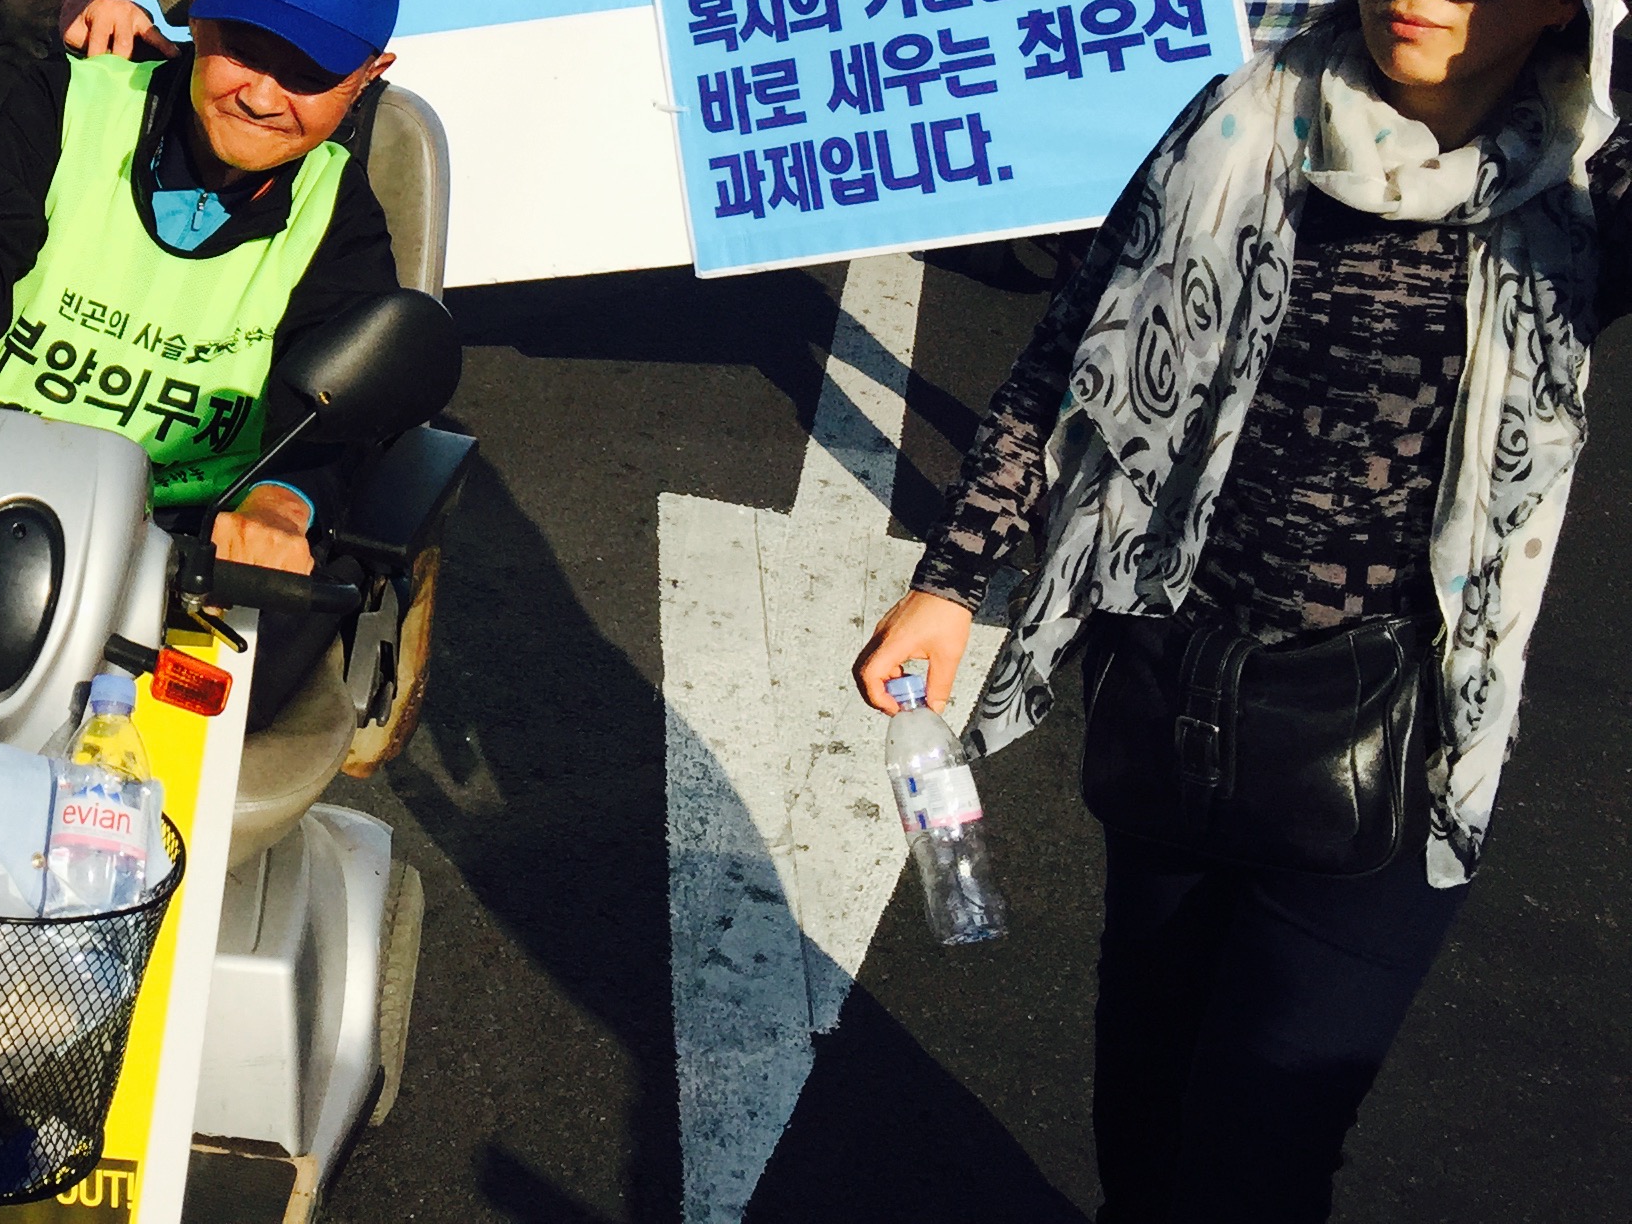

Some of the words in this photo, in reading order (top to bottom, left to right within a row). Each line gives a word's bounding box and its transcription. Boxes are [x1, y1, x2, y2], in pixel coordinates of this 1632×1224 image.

[696, 57, 807, 135] 바로
[827, 27, 999, 115] 세우는
[708, 112, 1015, 220] 과제입니다.
[57, 287, 131, 342] 빈곤의
[132, 322, 188, 363] 사슬
[62, 802, 133, 835] evian
